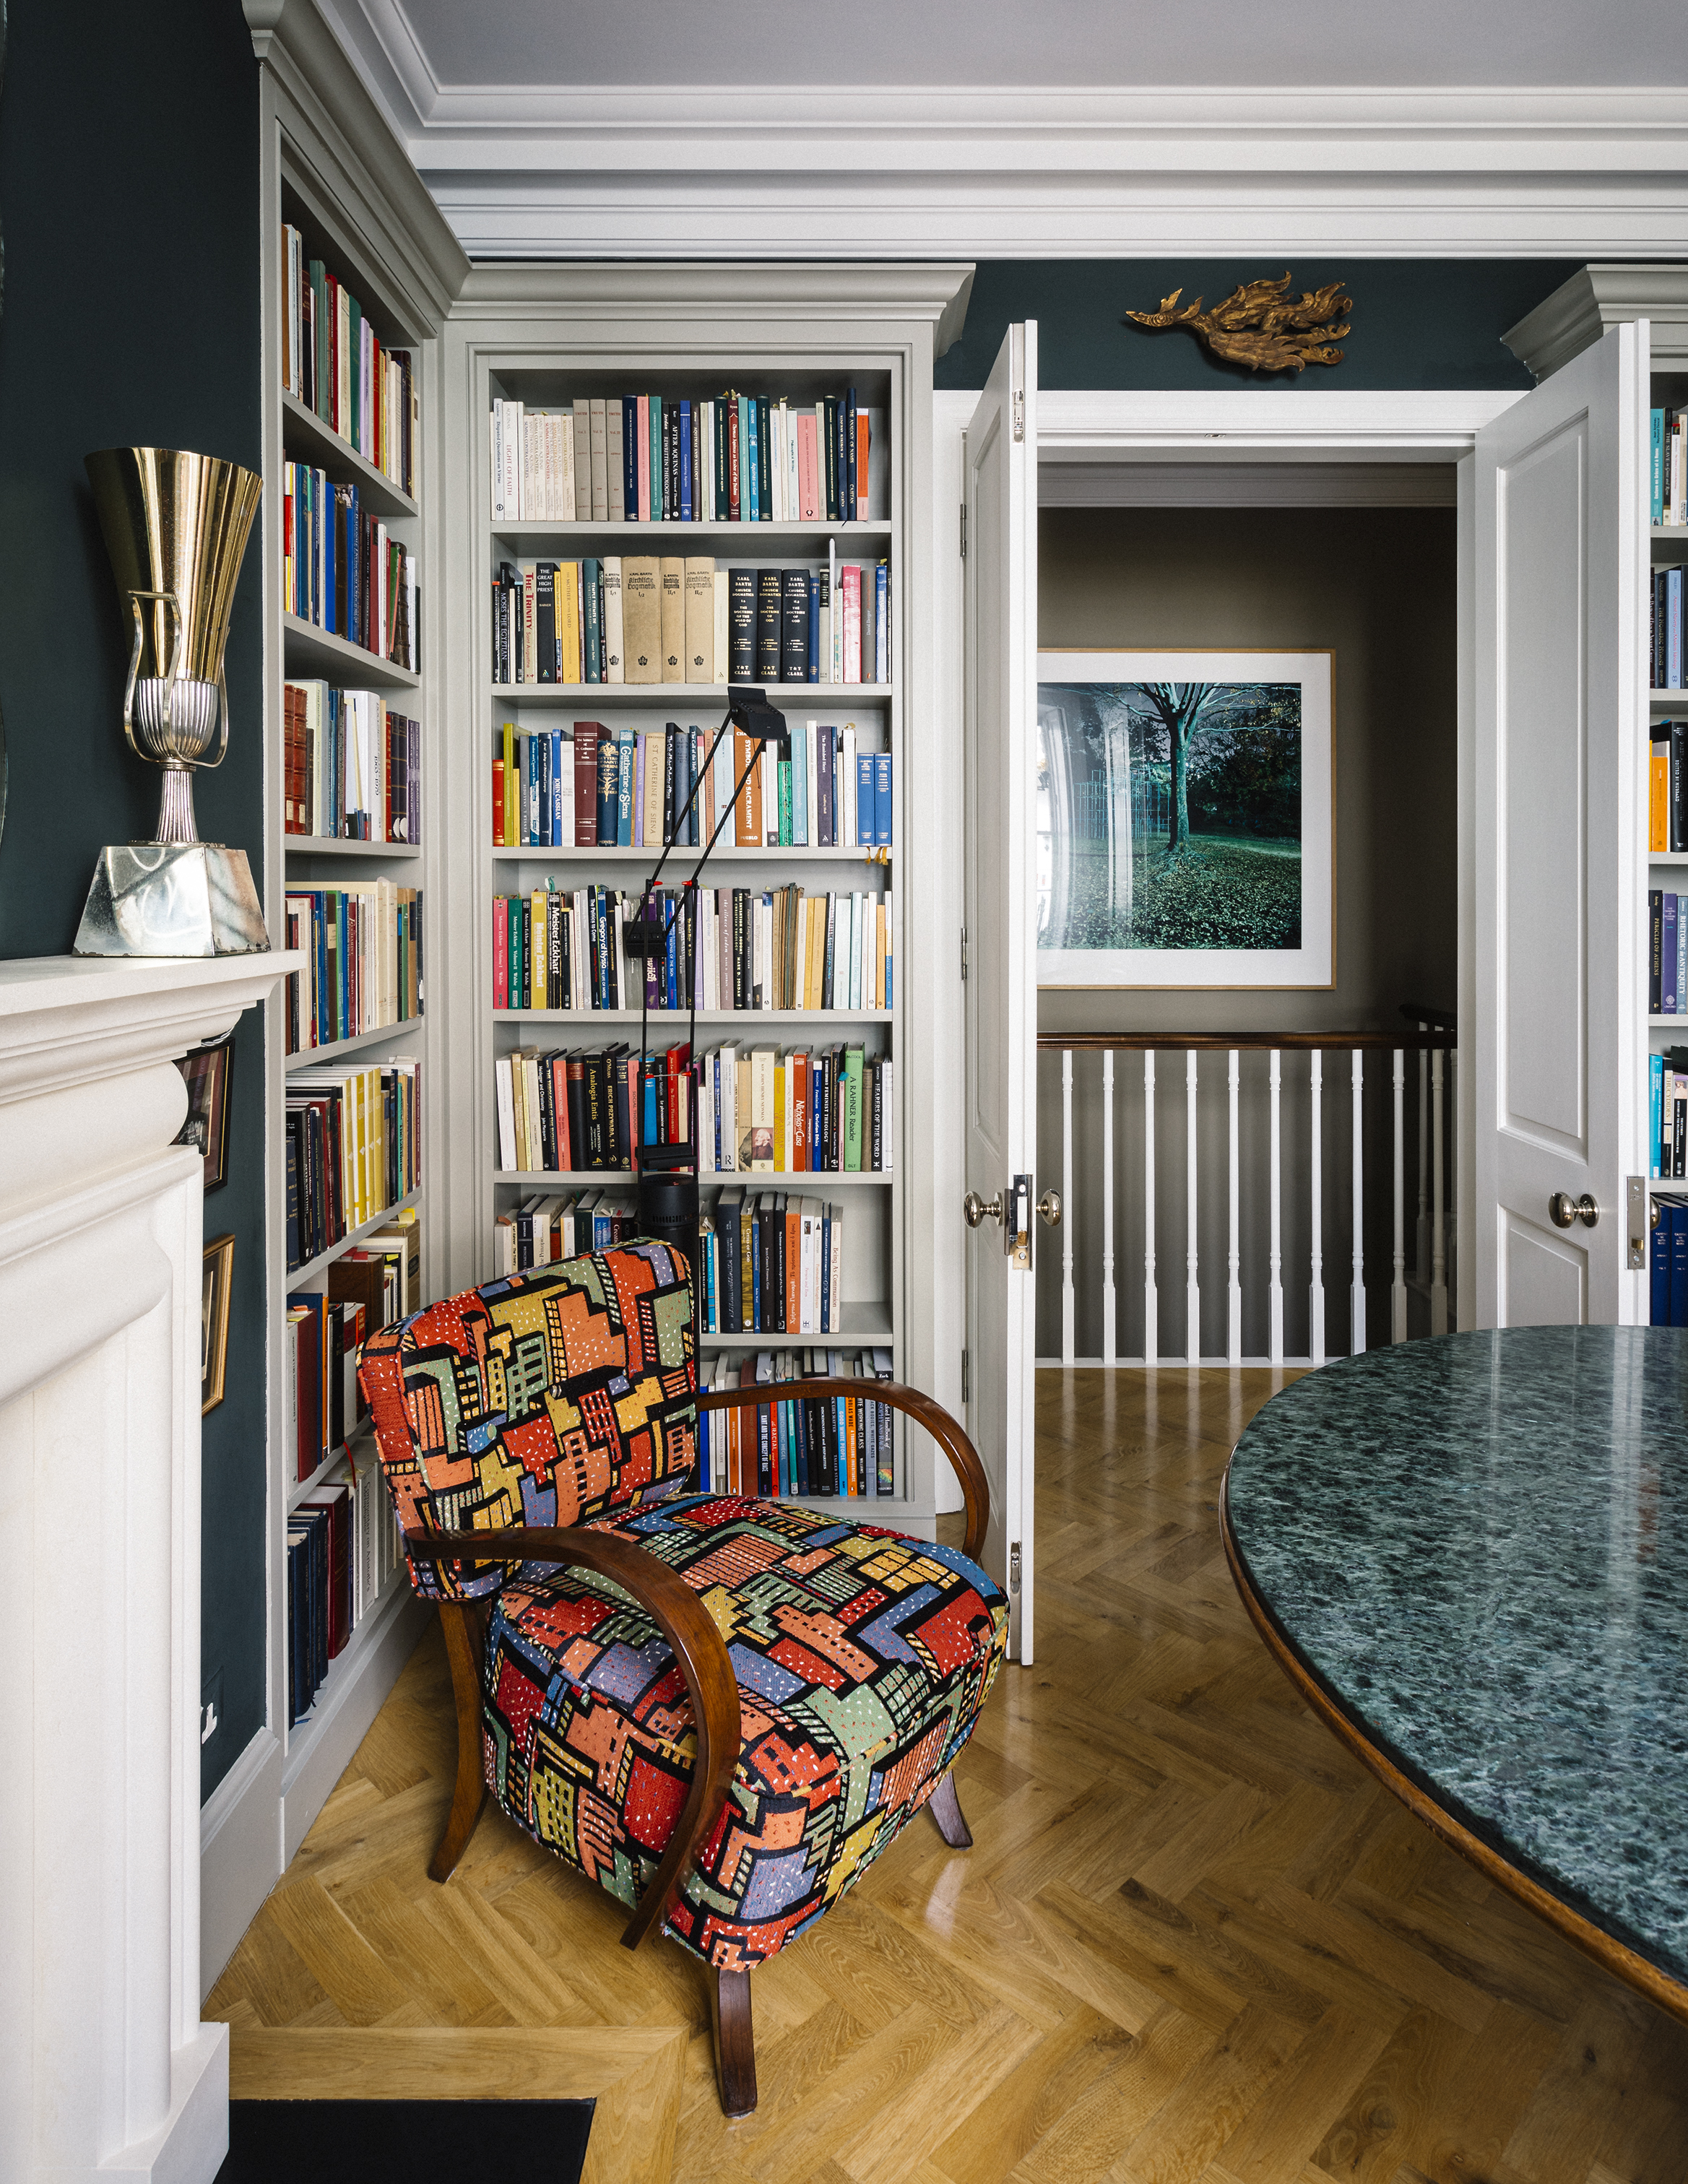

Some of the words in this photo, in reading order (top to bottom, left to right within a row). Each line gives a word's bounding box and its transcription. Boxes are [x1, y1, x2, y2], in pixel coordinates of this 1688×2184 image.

[507, 467, 511, 475] OF
[620, 745, 631, 787] Catherine
[620, 794, 630, 819] Siena
[652, 801, 657, 810] OF
[796, 1100, 805, 1127] Nicholas
[796, 1131, 805, 1146] Cusa
[367, 1538, 371, 1546] on
